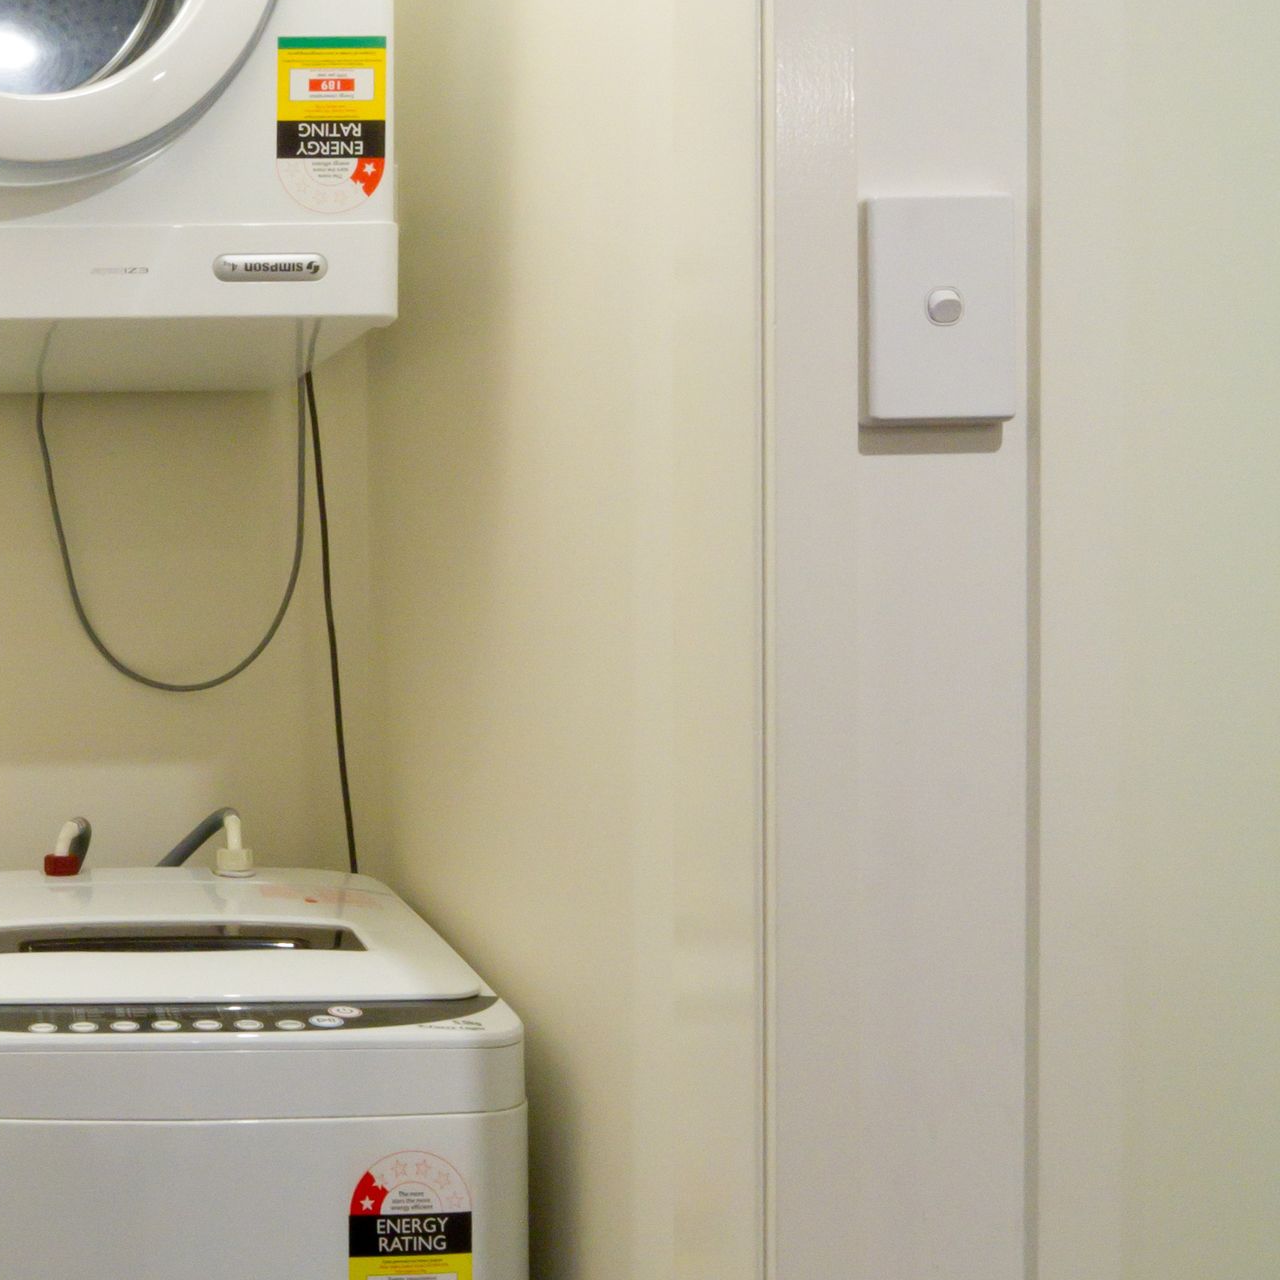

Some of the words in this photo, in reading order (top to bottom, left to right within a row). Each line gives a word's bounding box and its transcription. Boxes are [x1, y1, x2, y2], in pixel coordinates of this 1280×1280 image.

[320, 80, 341, 91] 189
[298, 123, 362, 138] RATING
[296, 141, 364, 156] ENERGY
[376, 1217, 449, 1235] ENERGY
[378, 1235, 447, 1252] RATING
